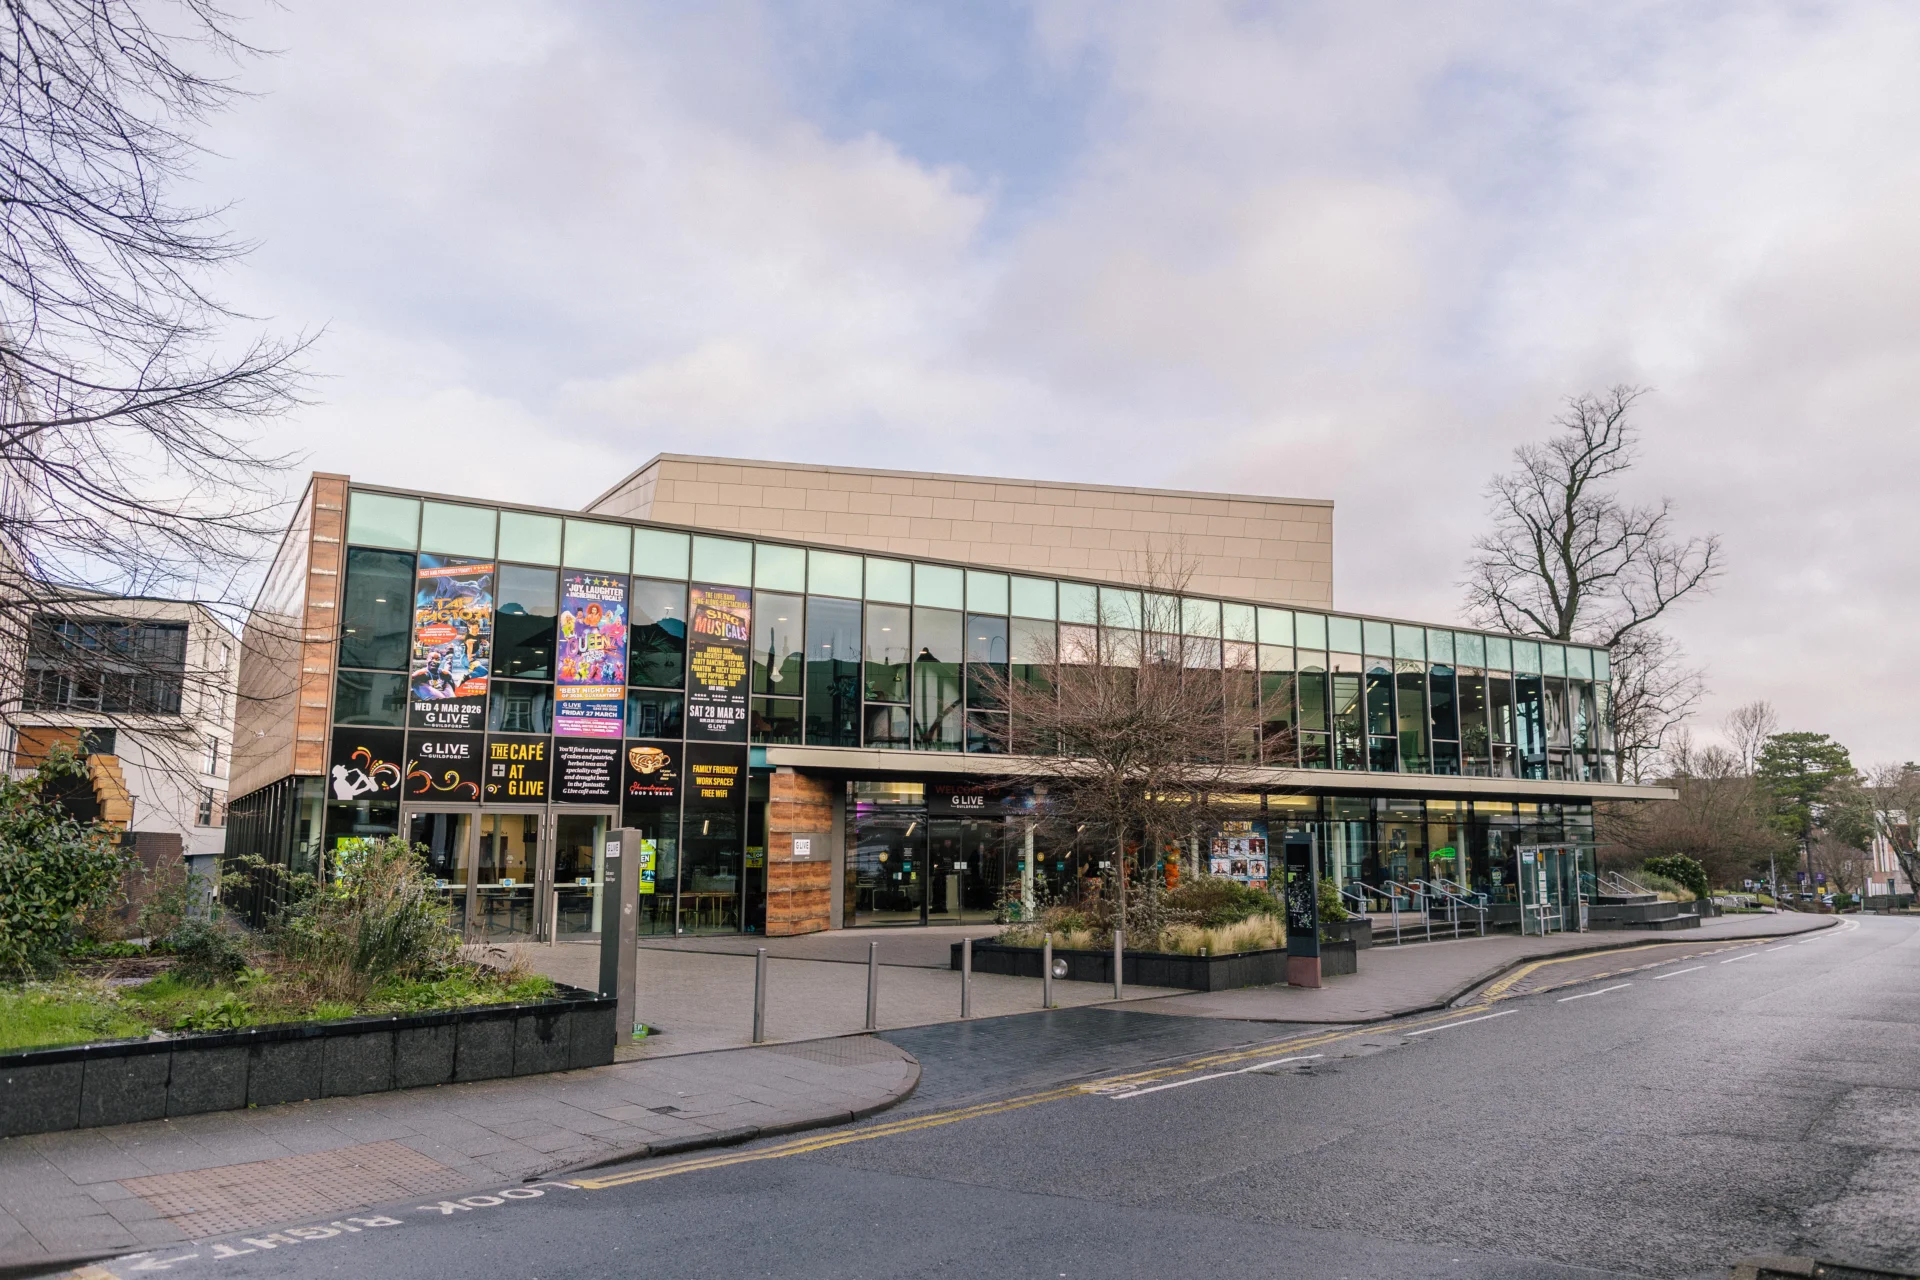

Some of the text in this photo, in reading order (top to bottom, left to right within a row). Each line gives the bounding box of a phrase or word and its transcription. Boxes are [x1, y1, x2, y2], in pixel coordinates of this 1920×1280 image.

[586, 586, 623, 596] LAUGHTER
[706, 610, 739, 626] SING
[694, 616, 748, 641] MUSICALS
[566, 633, 618, 658] QUEENZ
[415, 702, 482, 714] WED 4 MAR 2026
[690, 705, 745, 720] SAT 28 MAR 26
[426, 713, 469, 724] G LIVE
[422, 742, 469, 755] G LIVE
[491, 742, 544, 760] THE CAFÉ
[509, 765, 525, 779] AT
[692, 764, 738, 774] FAMILY FRIENDLY
[696, 777, 734, 786] WORK SPACES
[508, 781, 544, 796] G LIVE
[701, 789, 728, 798] FREE WiFi
[934, 785, 985, 794] WELCOME
[952, 795, 984, 805] G LIVE
[796, 841, 809, 850] G LIVE
[417, 1181, 580, 1214] LOOK
[211, 1215, 404, 1258] RIGHT
